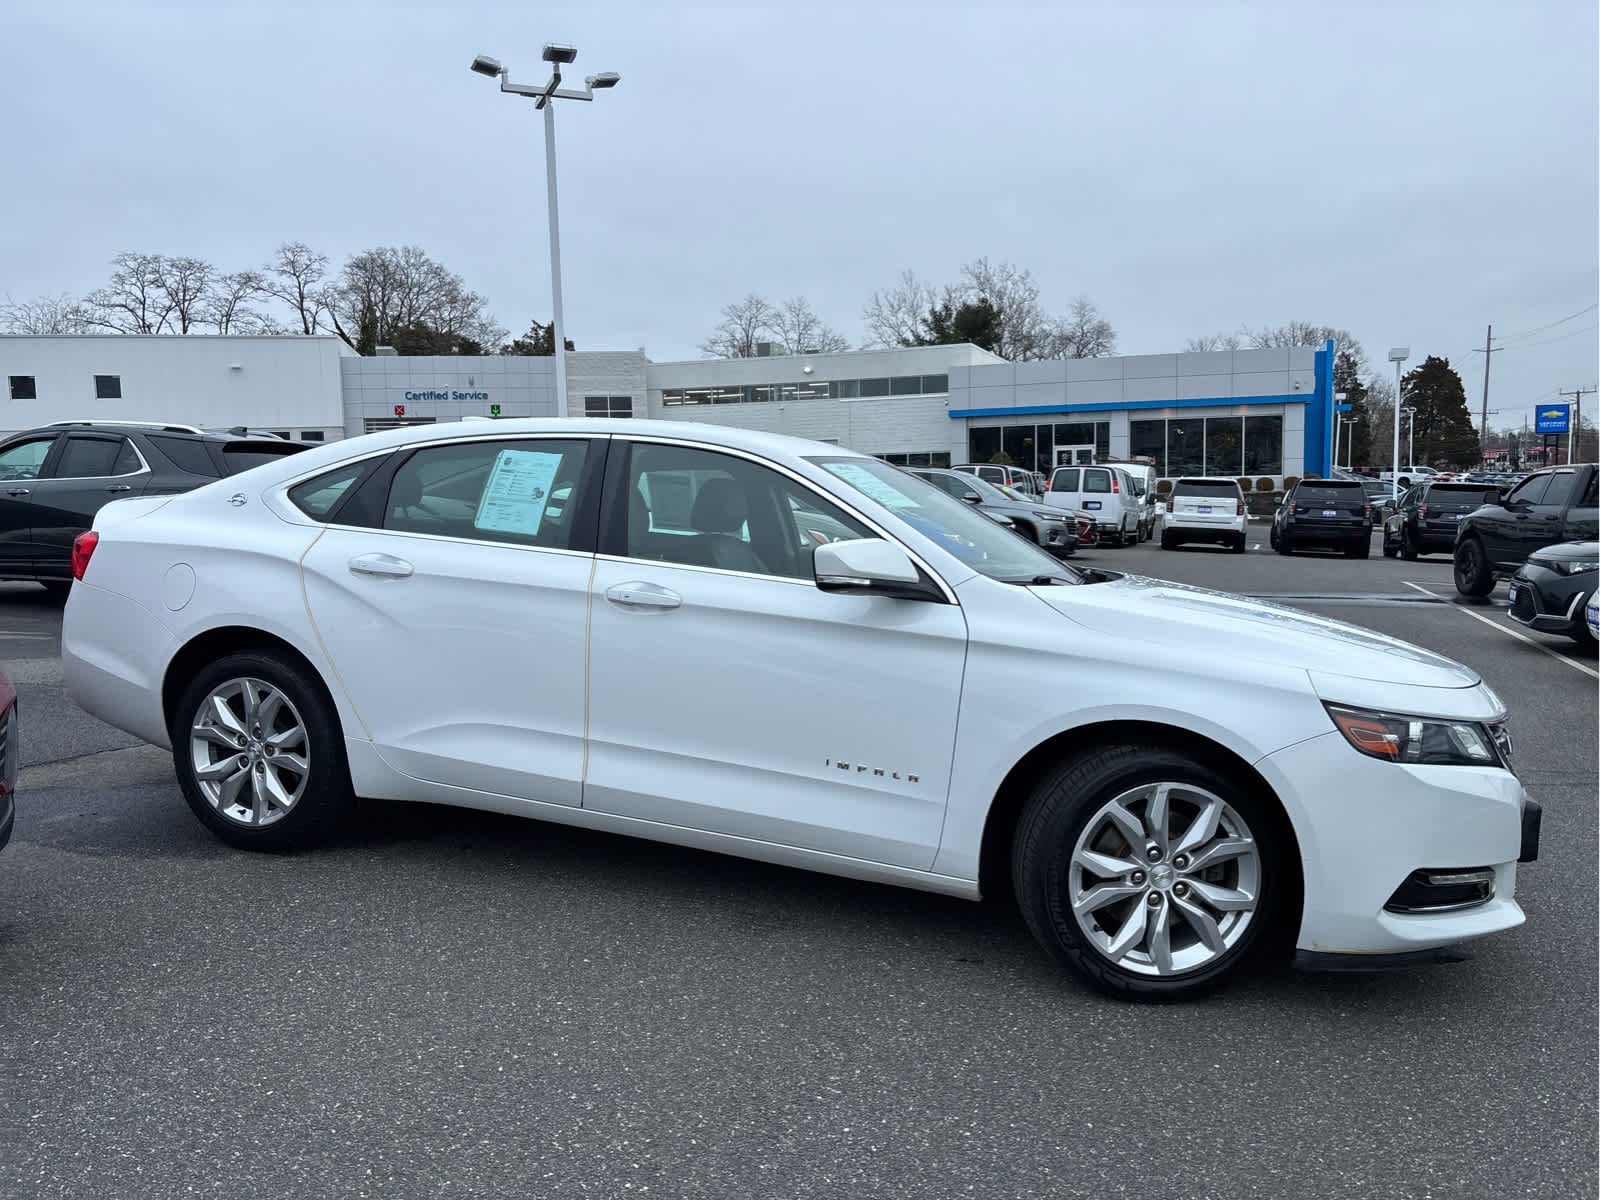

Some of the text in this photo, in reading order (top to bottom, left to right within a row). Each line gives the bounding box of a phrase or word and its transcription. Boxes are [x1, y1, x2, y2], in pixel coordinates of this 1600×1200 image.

[405, 391, 488, 400] Certified Service
[825, 759, 919, 783] IMPALA
